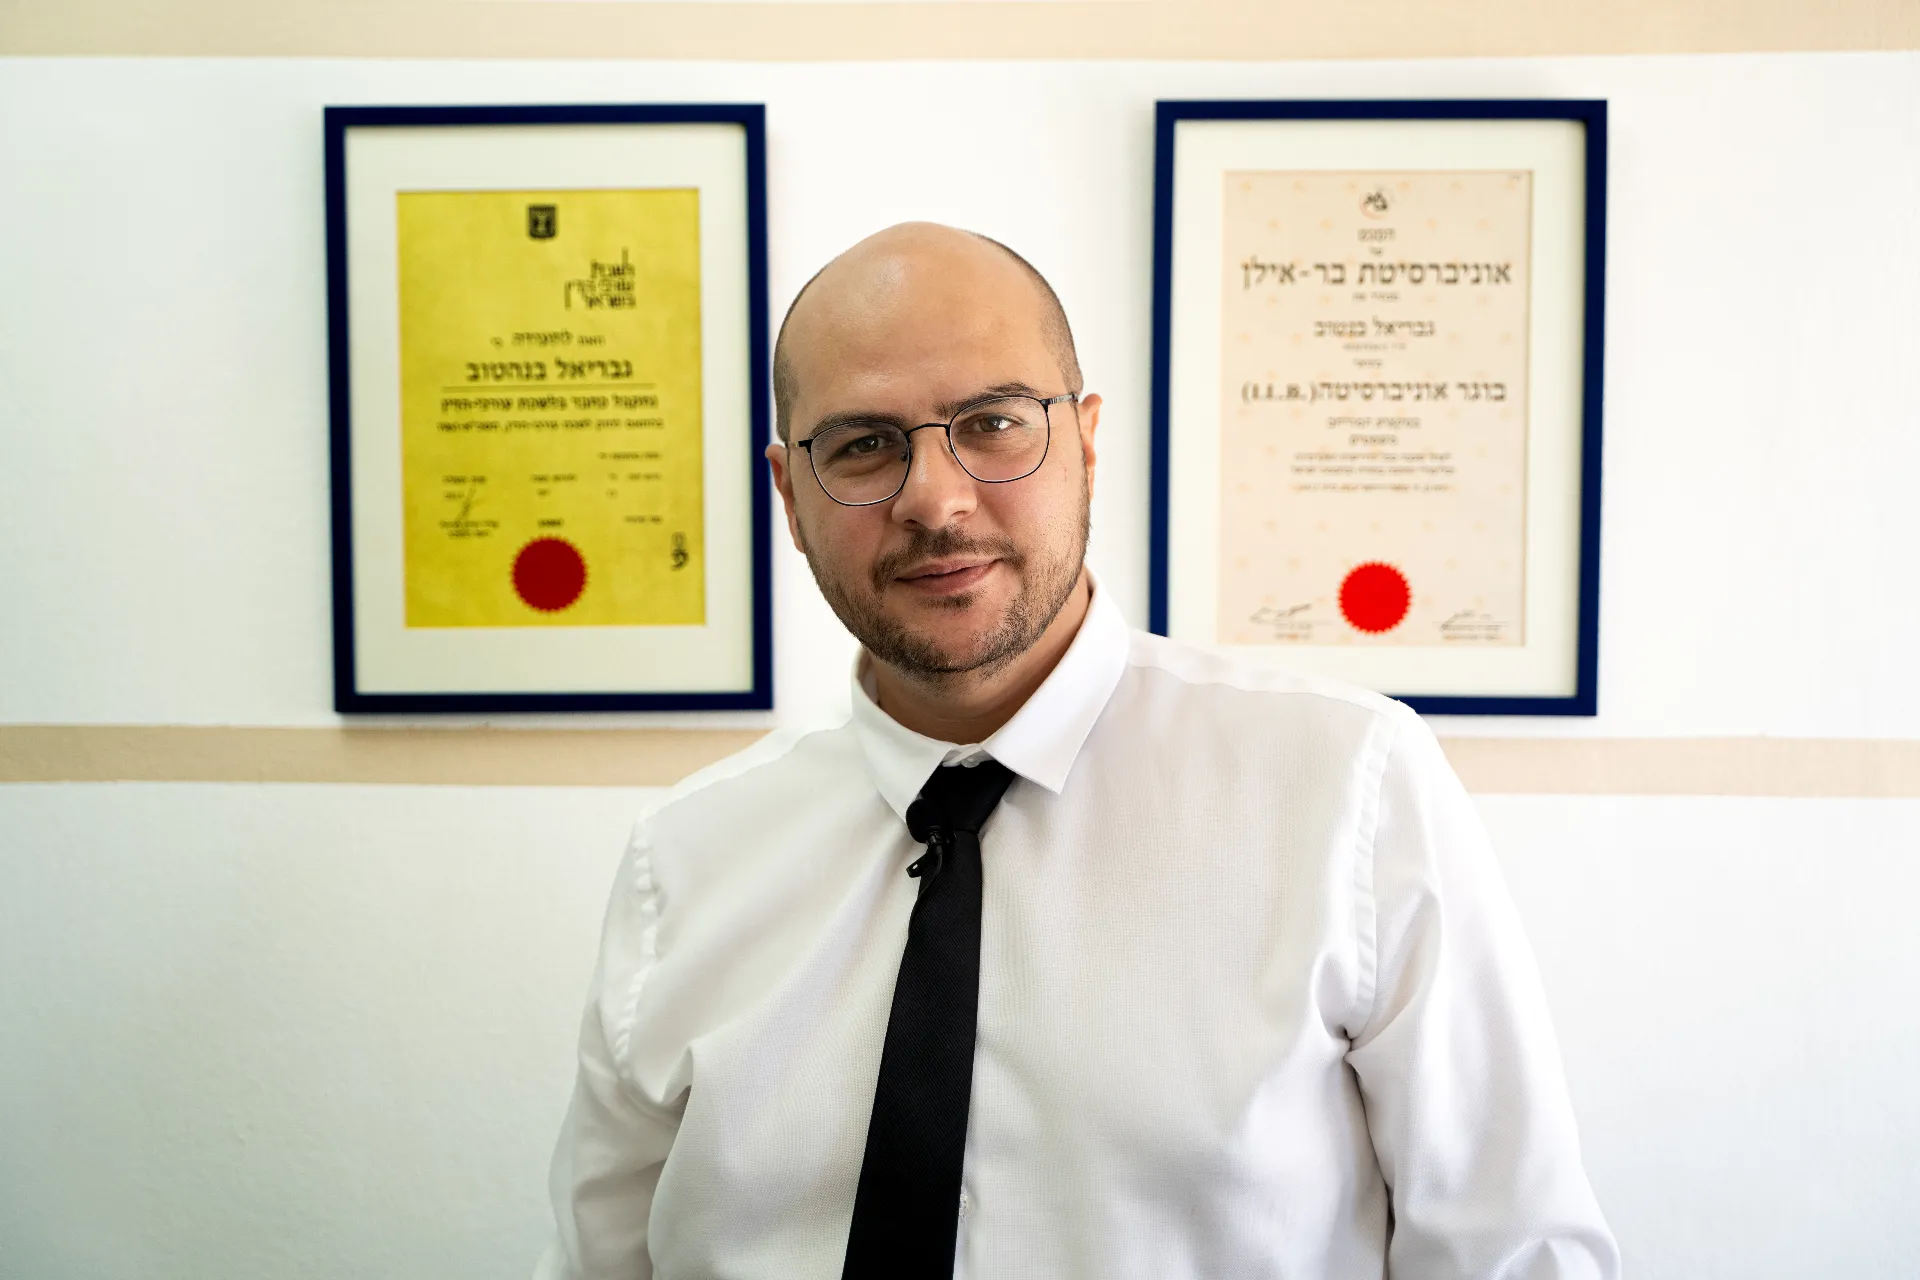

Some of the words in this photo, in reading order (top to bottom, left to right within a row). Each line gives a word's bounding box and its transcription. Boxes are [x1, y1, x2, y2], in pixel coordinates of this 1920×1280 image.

[1241, 256, 1347, 289] בר-אילן
[1356, 262, 1511, 285] אוניברסיטת
[1372, 315, 1436, 338] גבריאל
[465, 361, 548, 383] בנהטוב
[554, 357, 634, 380] גבריאל
[1456, 381, 1508, 402] בוגר
